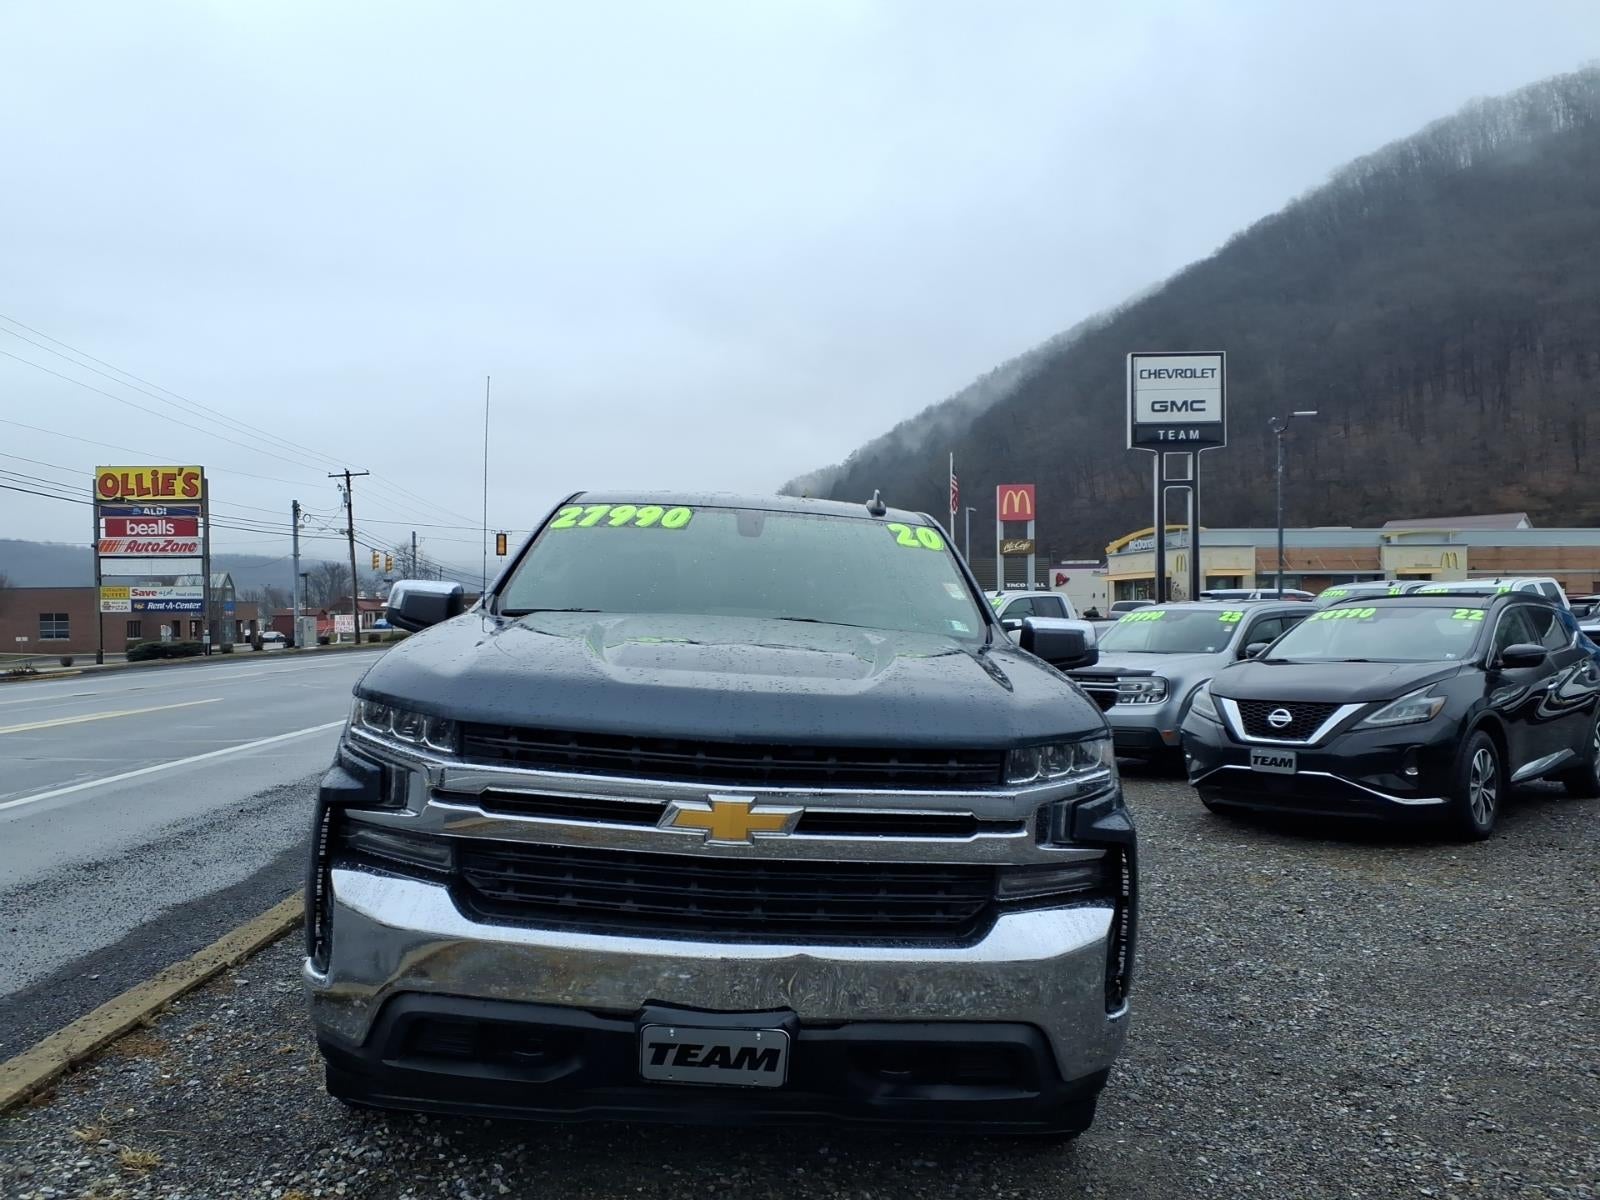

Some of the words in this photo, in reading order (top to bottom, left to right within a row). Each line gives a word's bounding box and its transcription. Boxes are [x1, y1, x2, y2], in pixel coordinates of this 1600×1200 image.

[1139, 367, 1217, 380] CHEVROLET
[1151, 399, 1206, 413] GMC
[1158, 429, 1200, 441] TEAM
[549, 504, 693, 530] 27990
[126, 520, 174, 535] bealls
[887, 522, 945, 552] 20
[124, 540, 198, 553] AutoZone
[131, 588, 157, 597] Save
[1452, 609, 1485, 620] 22
[1252, 756, 1293, 768] TEAM
[648, 1042, 782, 1073] TEAM
